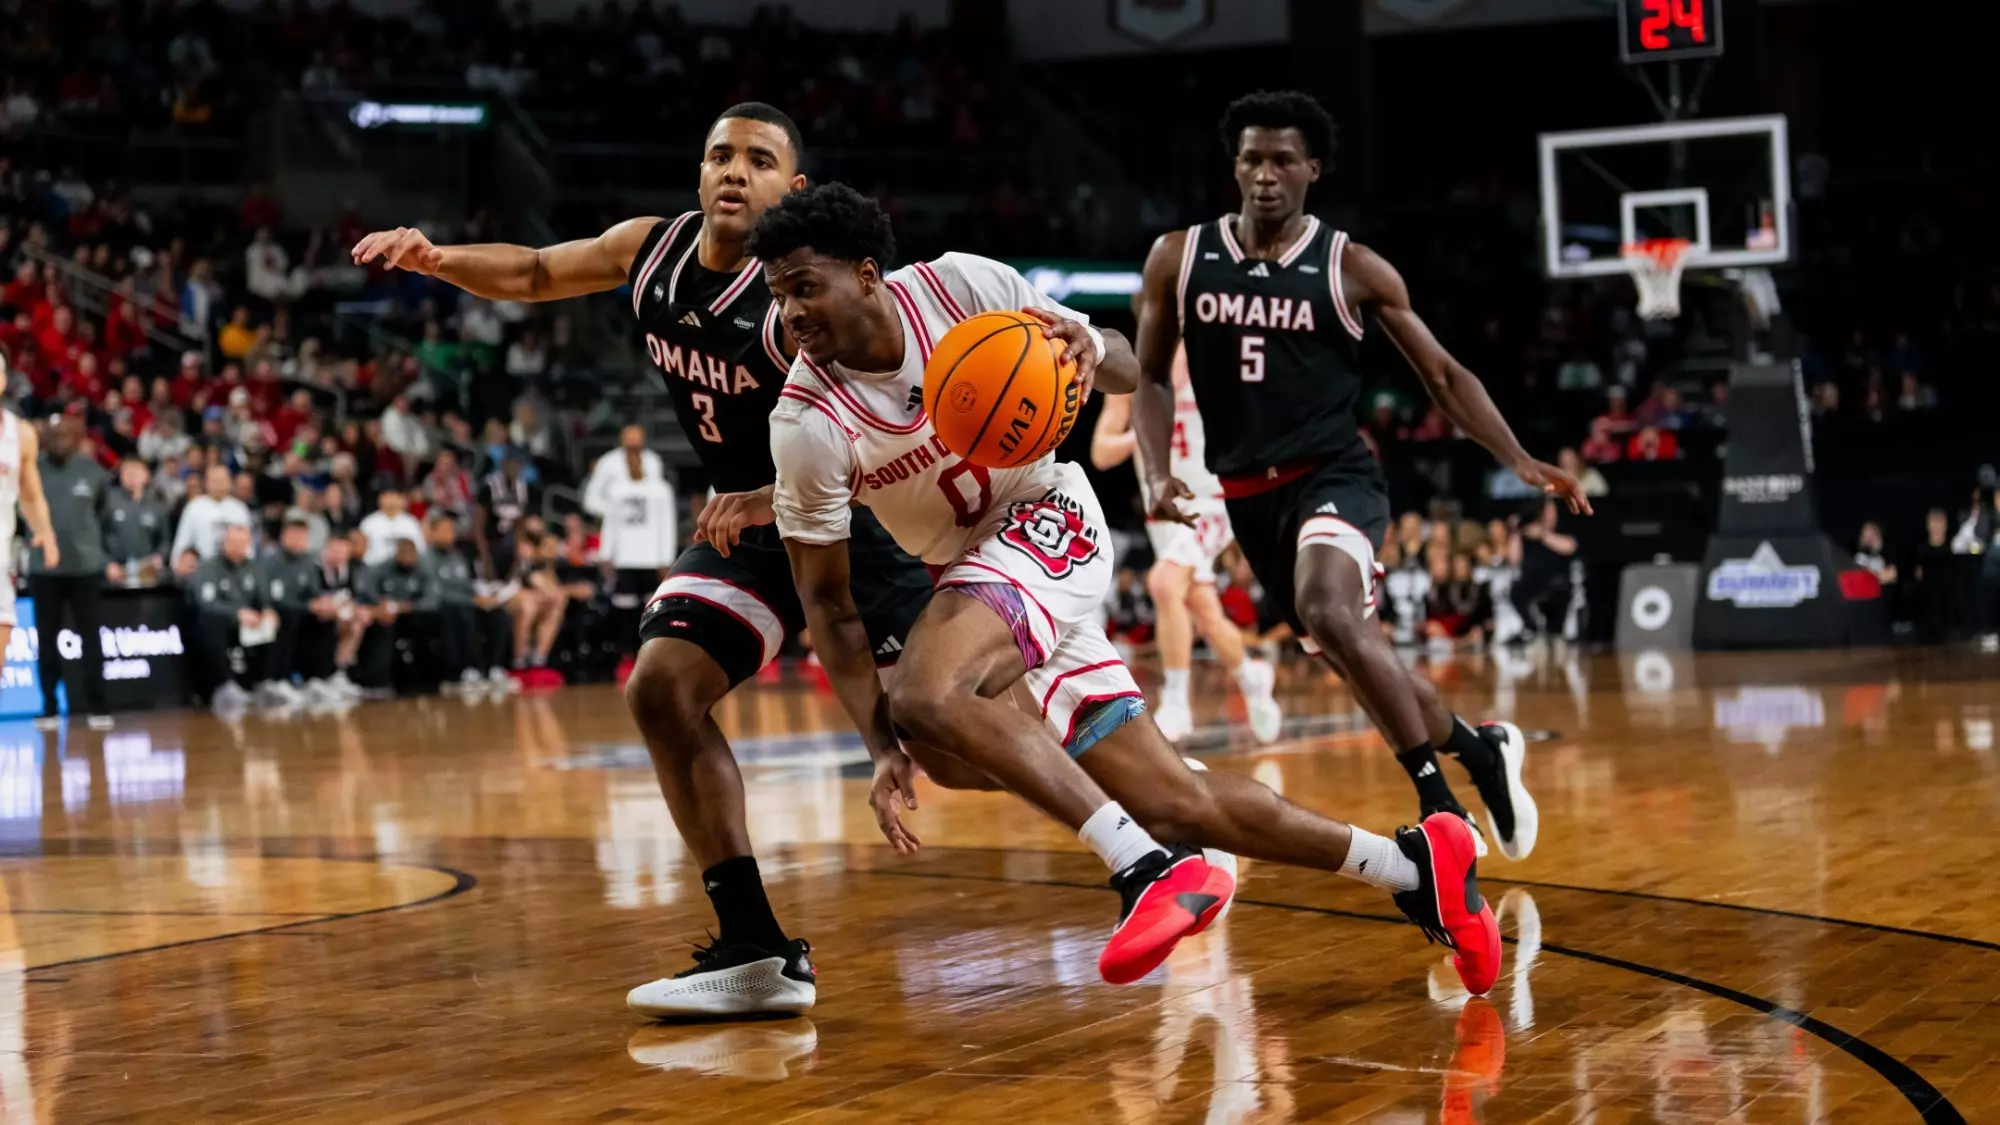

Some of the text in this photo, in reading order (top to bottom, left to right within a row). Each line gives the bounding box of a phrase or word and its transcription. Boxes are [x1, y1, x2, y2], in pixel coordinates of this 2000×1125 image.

[1640, 0, 1705, 49] 24
[1195, 291, 1316, 332] OMAHA
[645, 332, 761, 395] OMAHA
[1240, 336, 1266, 382] 5
[691, 391, 723, 443] 3
[998, 396, 1038, 455] EVO
[863, 444, 936, 490] SOUTH
[937, 459, 992, 529] 0
